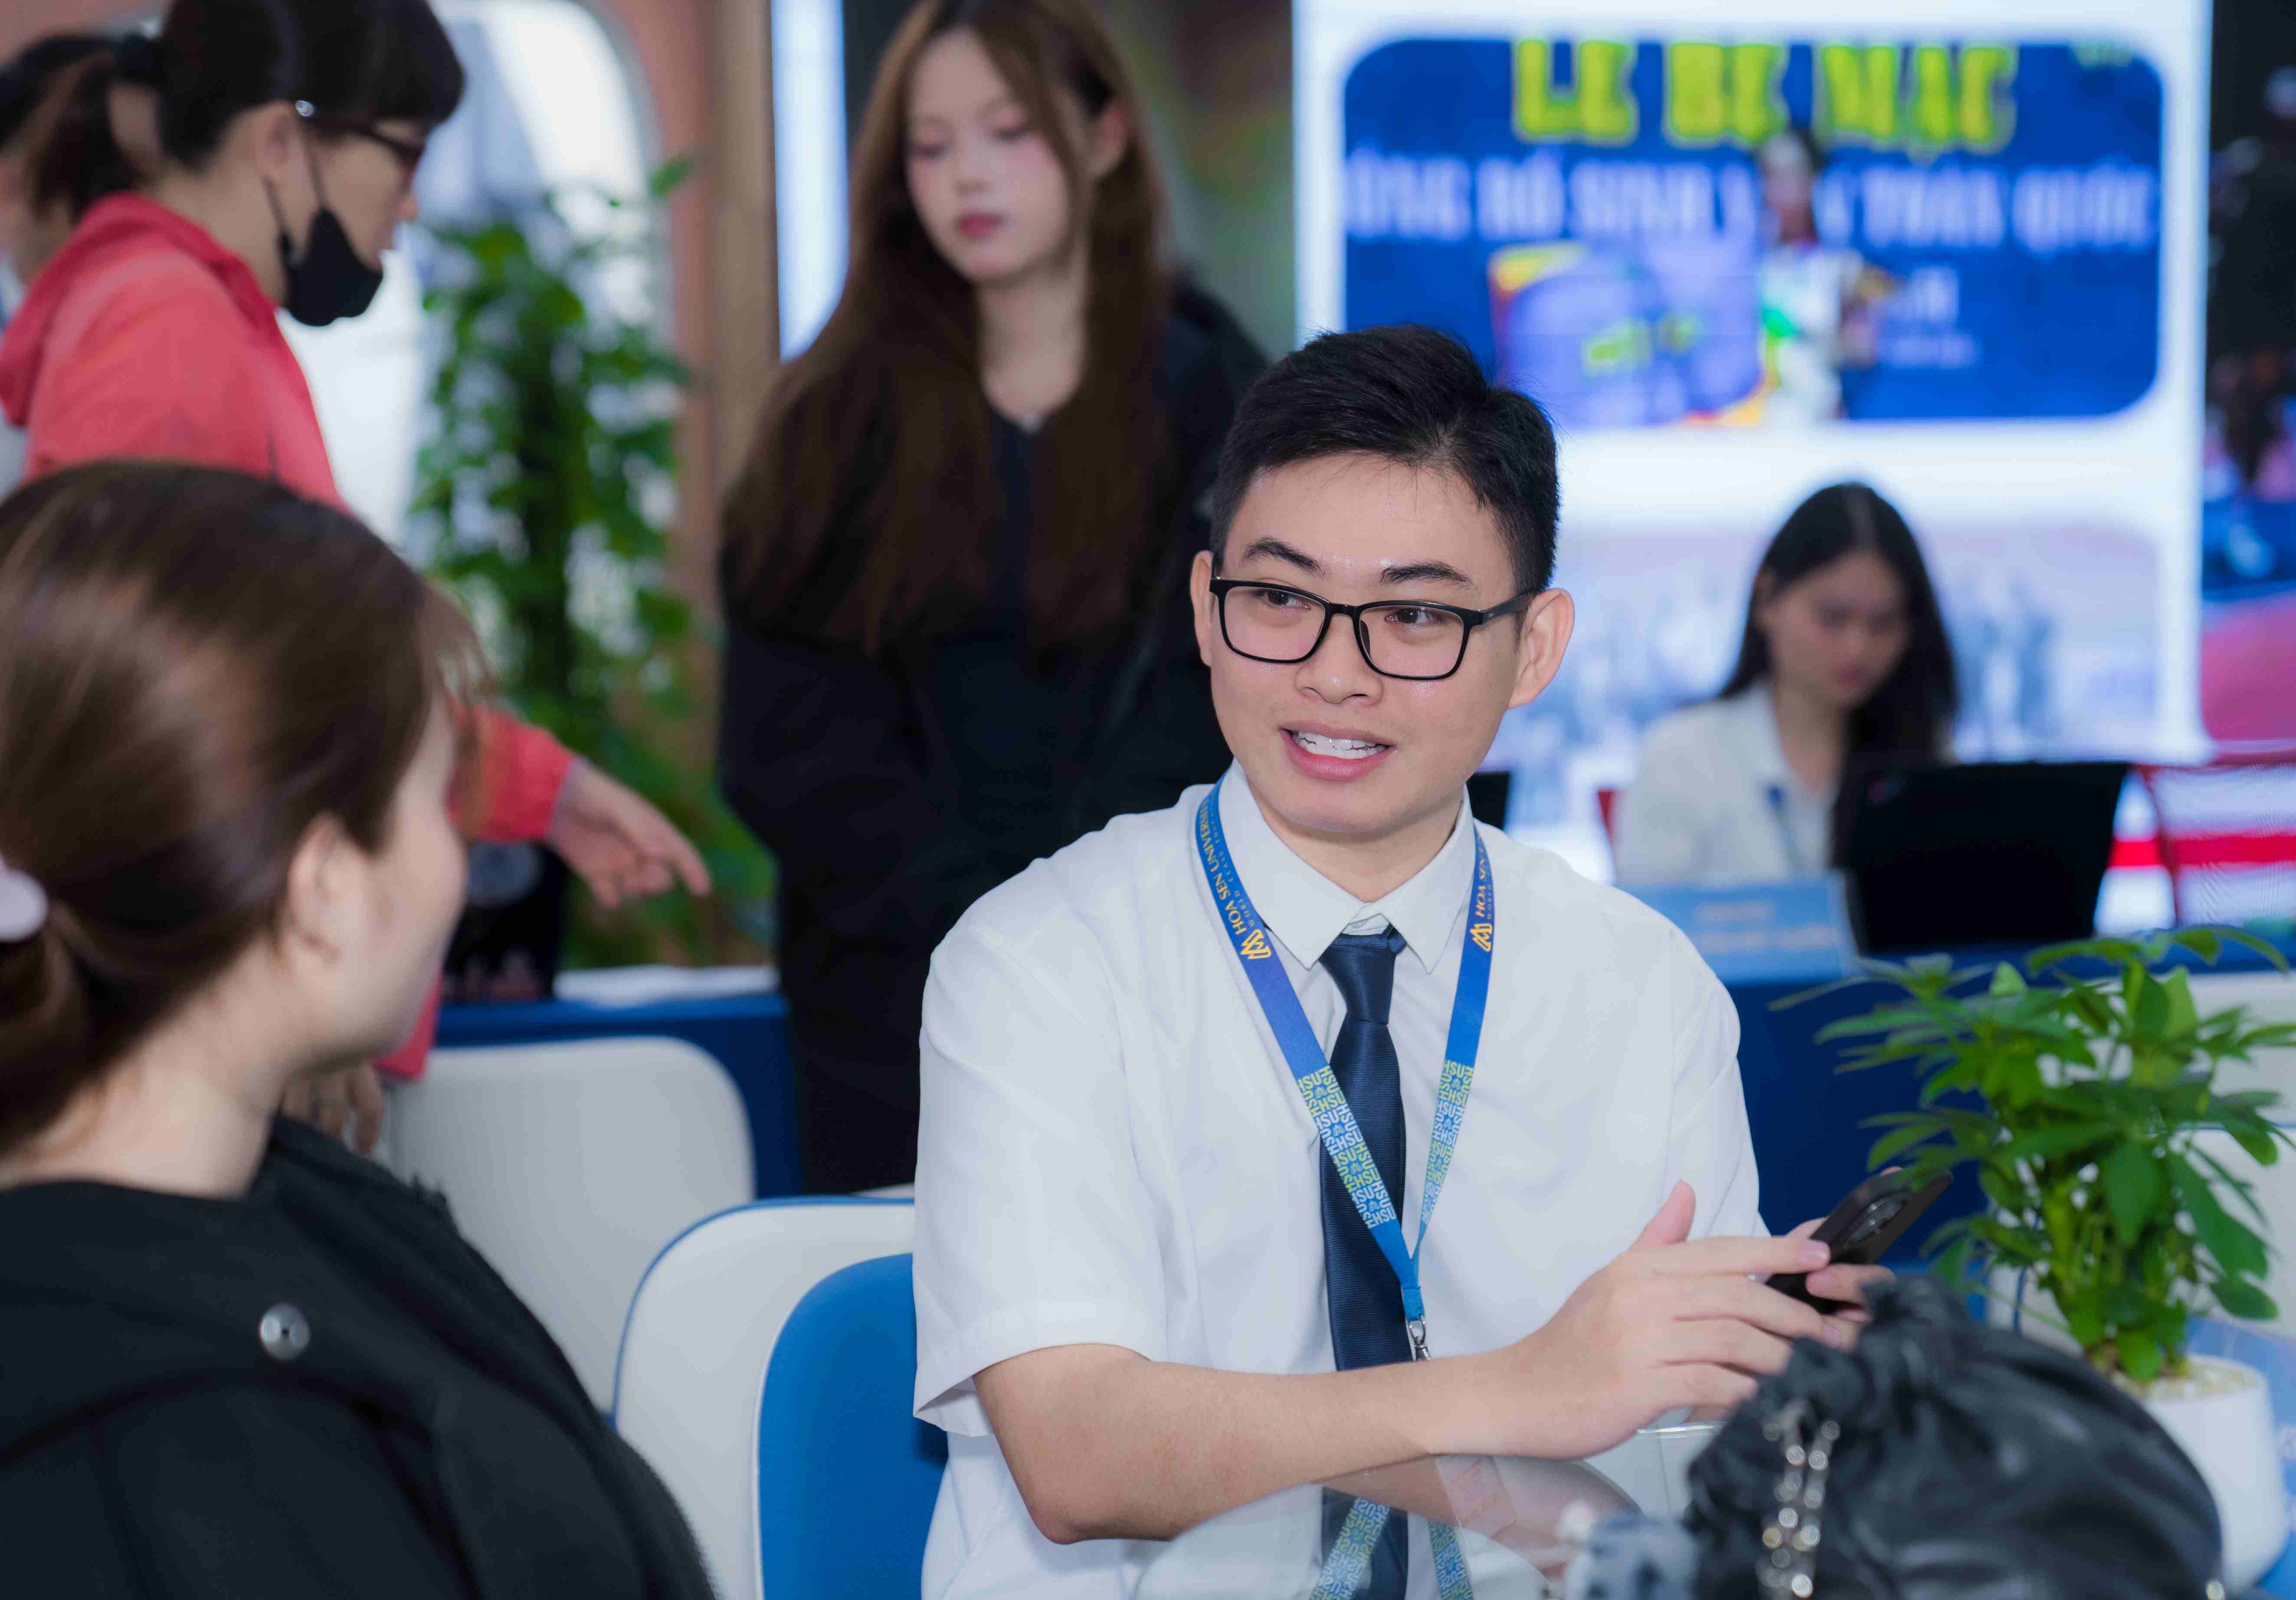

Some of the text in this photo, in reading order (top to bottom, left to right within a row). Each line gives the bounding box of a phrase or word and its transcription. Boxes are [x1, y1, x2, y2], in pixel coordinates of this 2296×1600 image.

[1213, 872, 1231, 900] SEN
[1475, 885, 1486, 918] HOA
[1225, 900, 1248, 935] HOA
[1444, 1059, 1465, 1079] HSU
[1318, 1090, 1346, 1112] HSU
[1336, 1128, 1363, 1151] HSU
[1353, 1166, 1381, 1188] HSU
[1372, 1204, 1397, 1226] HSU
